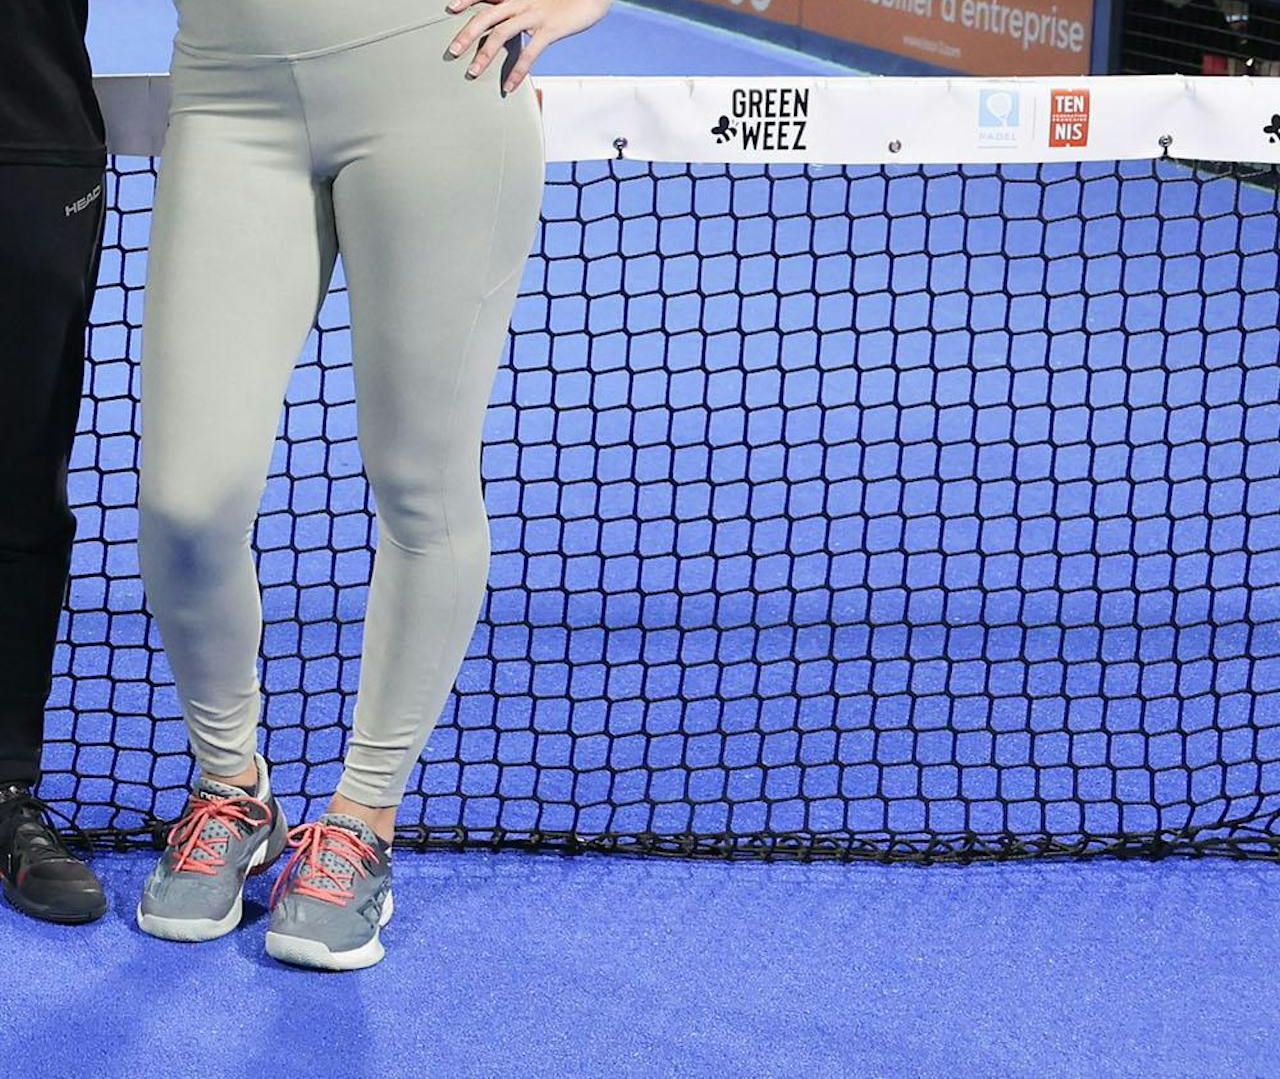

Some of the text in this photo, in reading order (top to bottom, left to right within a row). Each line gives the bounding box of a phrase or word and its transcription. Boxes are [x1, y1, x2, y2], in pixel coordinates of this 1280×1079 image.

[732, 88, 809, 118] GREEN
[1055, 95, 1085, 113] TEN
[741, 121, 806, 150] WEEZ
[1055, 123, 1083, 140] NIS
